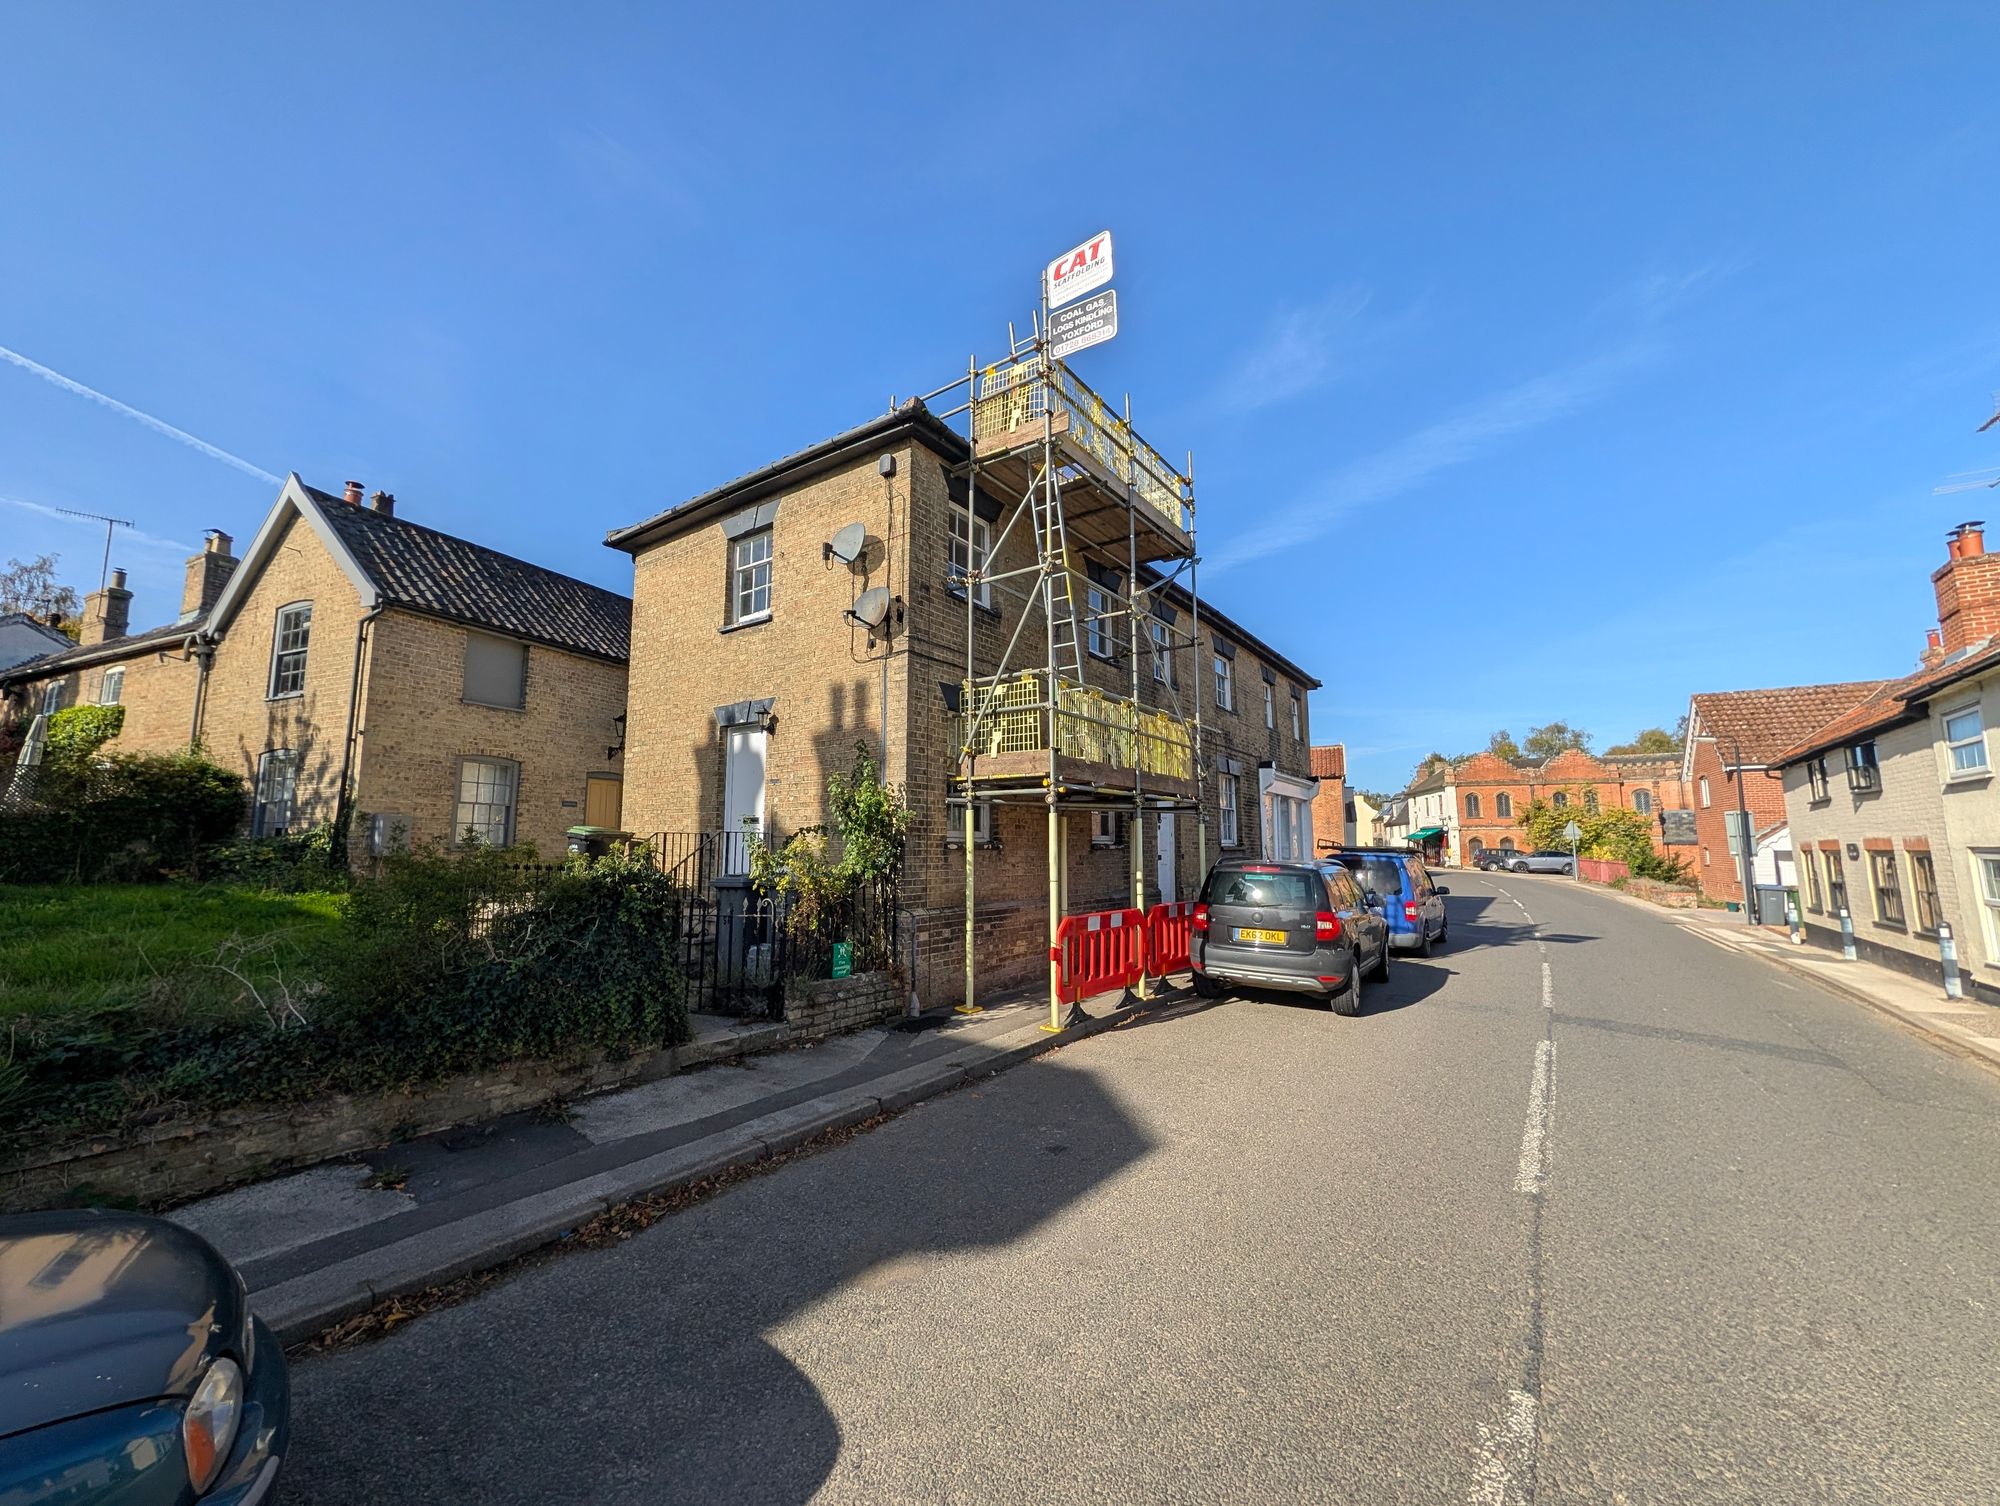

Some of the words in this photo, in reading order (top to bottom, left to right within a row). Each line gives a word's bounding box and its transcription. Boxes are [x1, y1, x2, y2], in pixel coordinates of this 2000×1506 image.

[1053, 237, 1105, 281] CAT
[1053, 257, 1105, 289] SCAFFOLDING
[1052, 321, 1074, 335] LOGS
[1074, 306, 1113, 327] KINDLING
[1061, 308, 1084, 322] COAL
[1061, 319, 1104, 341] YOXFORD
[1240, 929, 1264, 940] EK62
